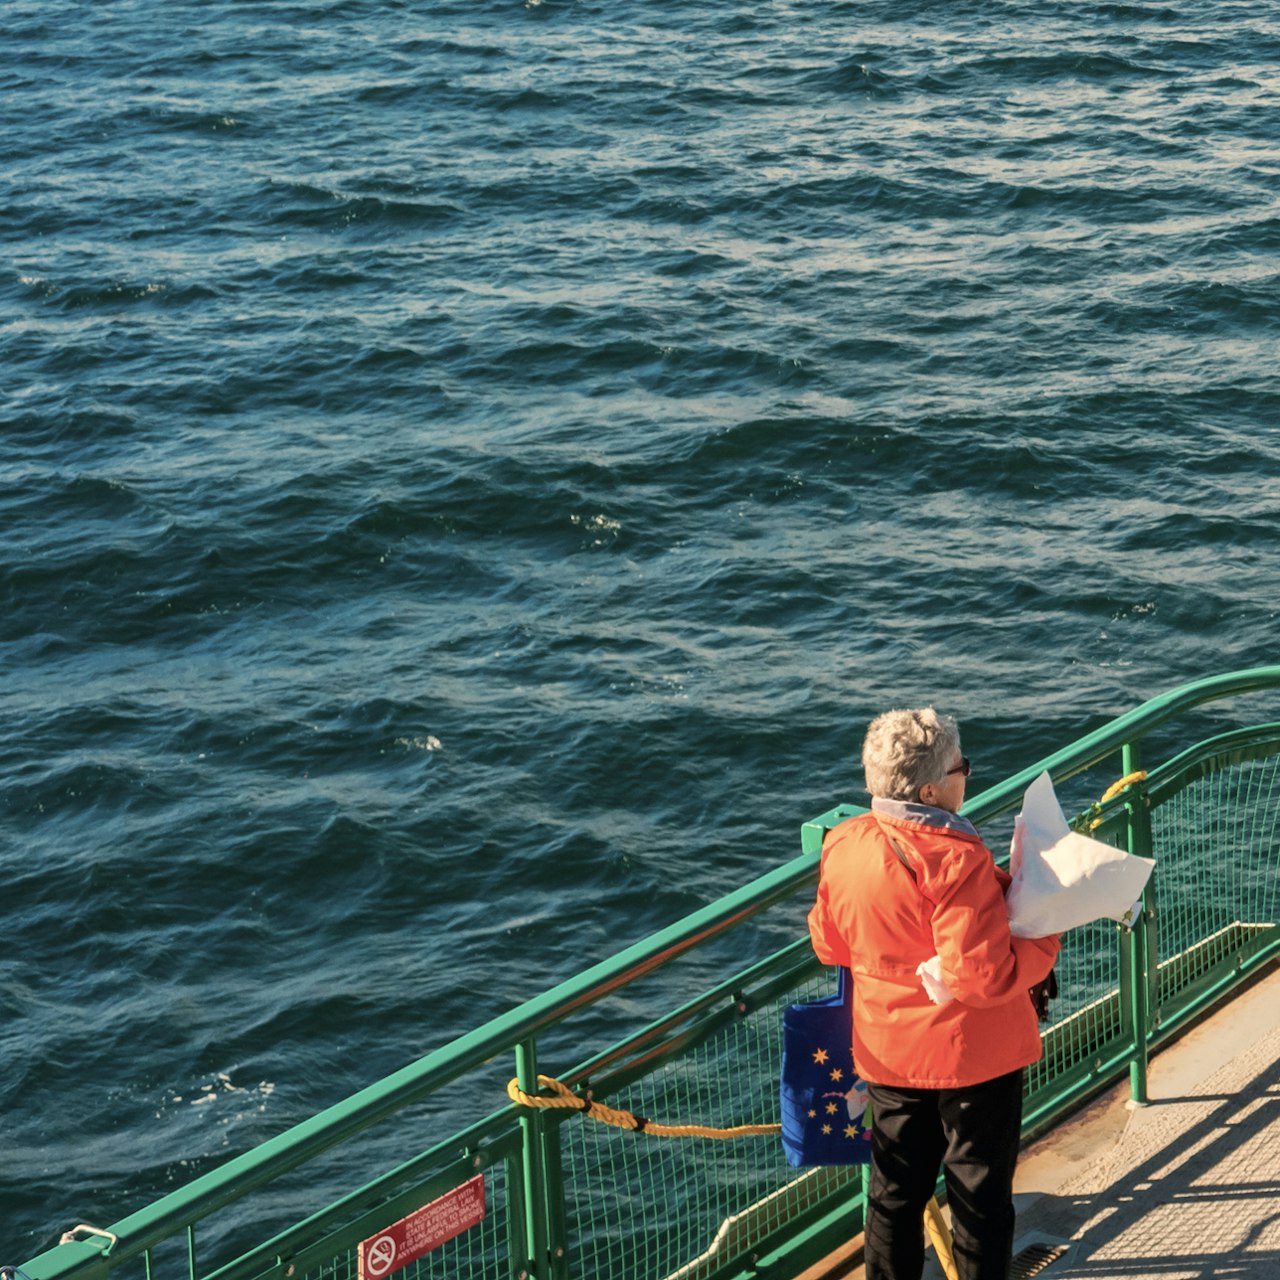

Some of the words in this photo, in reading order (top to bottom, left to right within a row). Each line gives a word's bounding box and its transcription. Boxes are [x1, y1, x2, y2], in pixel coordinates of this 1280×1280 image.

[399, 1242, 406, 1250] IT
[407, 1238, 414, 1246] IS
[414, 1219, 448, 1242] UNLAWFUL
[449, 1212, 458, 1222] TO
[458, 1199, 480, 1216] SMOKE
[406, 1222, 413, 1230] IN
[414, 1196, 457, 1226] ACCORDANCE
[458, 1187, 474, 1200] WITH
[406, 1225, 425, 1239] STATE
[432, 1204, 459, 1223] FEDERAL
[460, 1195, 475, 1207] LAW
[397, 1235, 433, 1260] ANYWHERE
[434, 1228, 444, 1239] ON
[445, 1220, 460, 1232] THIS
[460, 1206, 483, 1224] VESSEL
